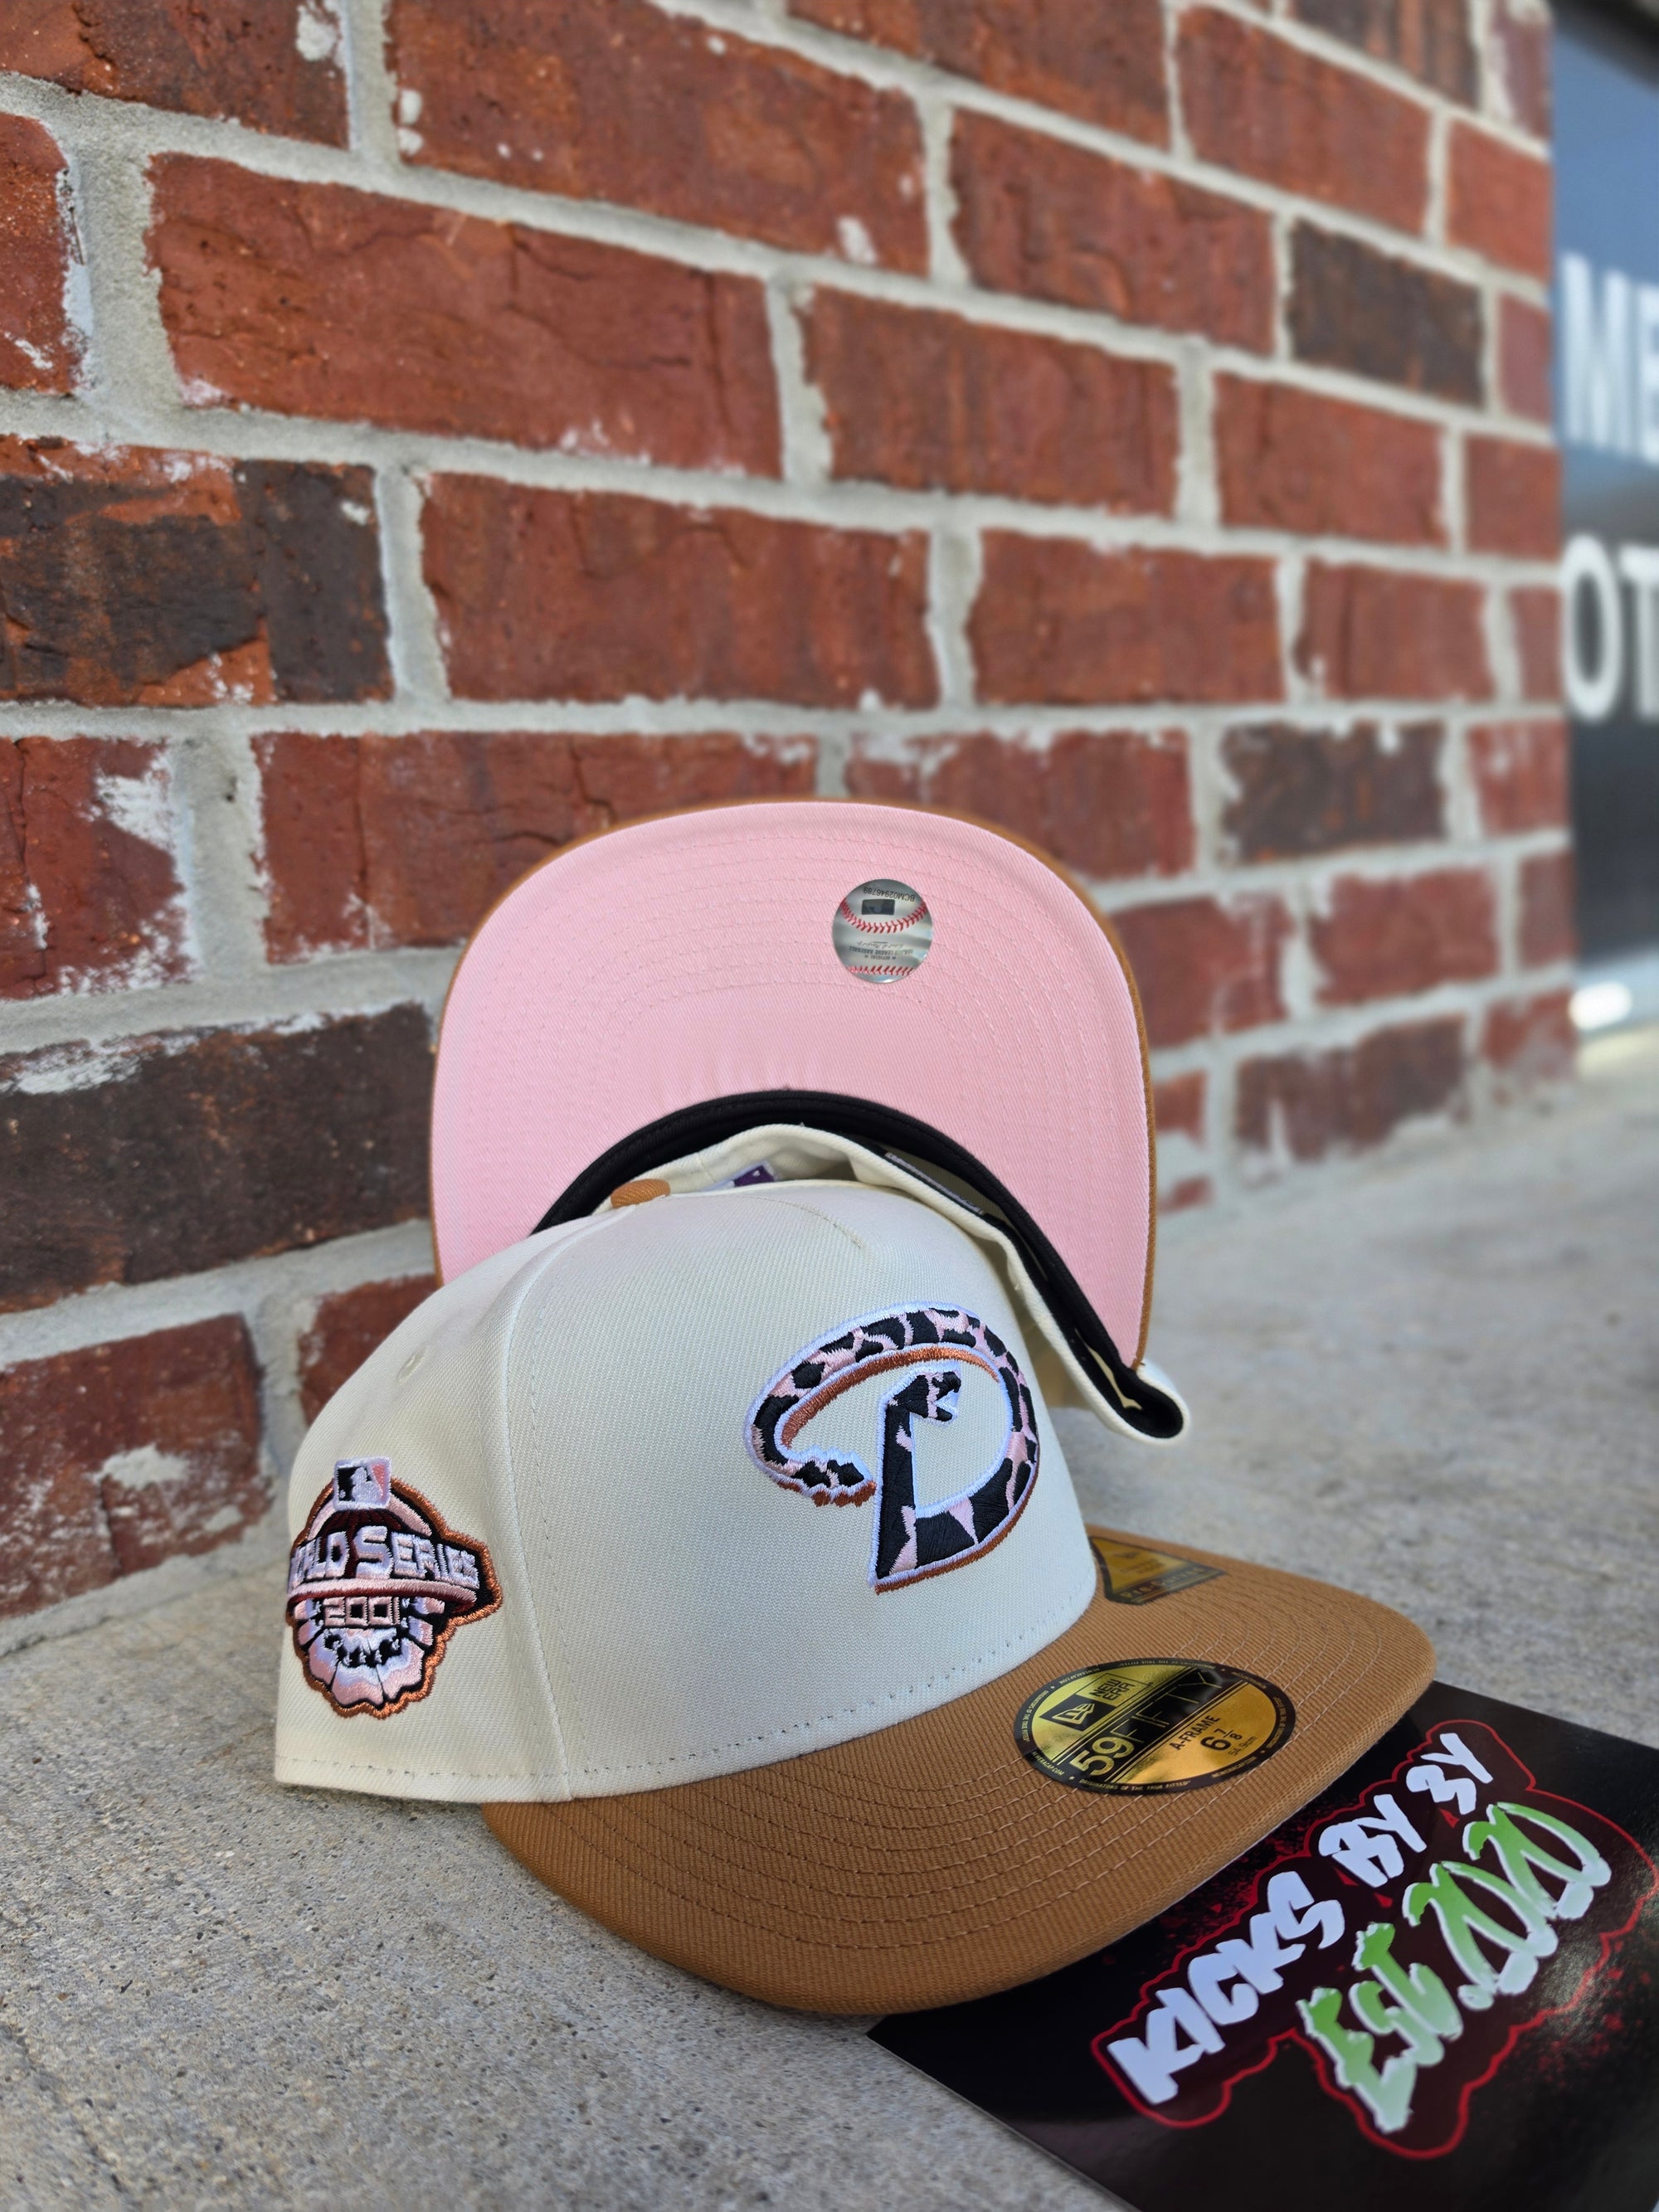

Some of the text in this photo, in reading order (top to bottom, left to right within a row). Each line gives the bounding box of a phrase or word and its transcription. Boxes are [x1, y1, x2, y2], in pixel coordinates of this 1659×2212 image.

[1088, 1678, 1120, 1698] NEW
[1102, 1683, 1136, 1700] ERA
[1170, 1714, 1220, 1751] A-FRAME
[1107, 1869, 1345, 2104] KICKS
[1318, 1793, 1428, 1888] BY
